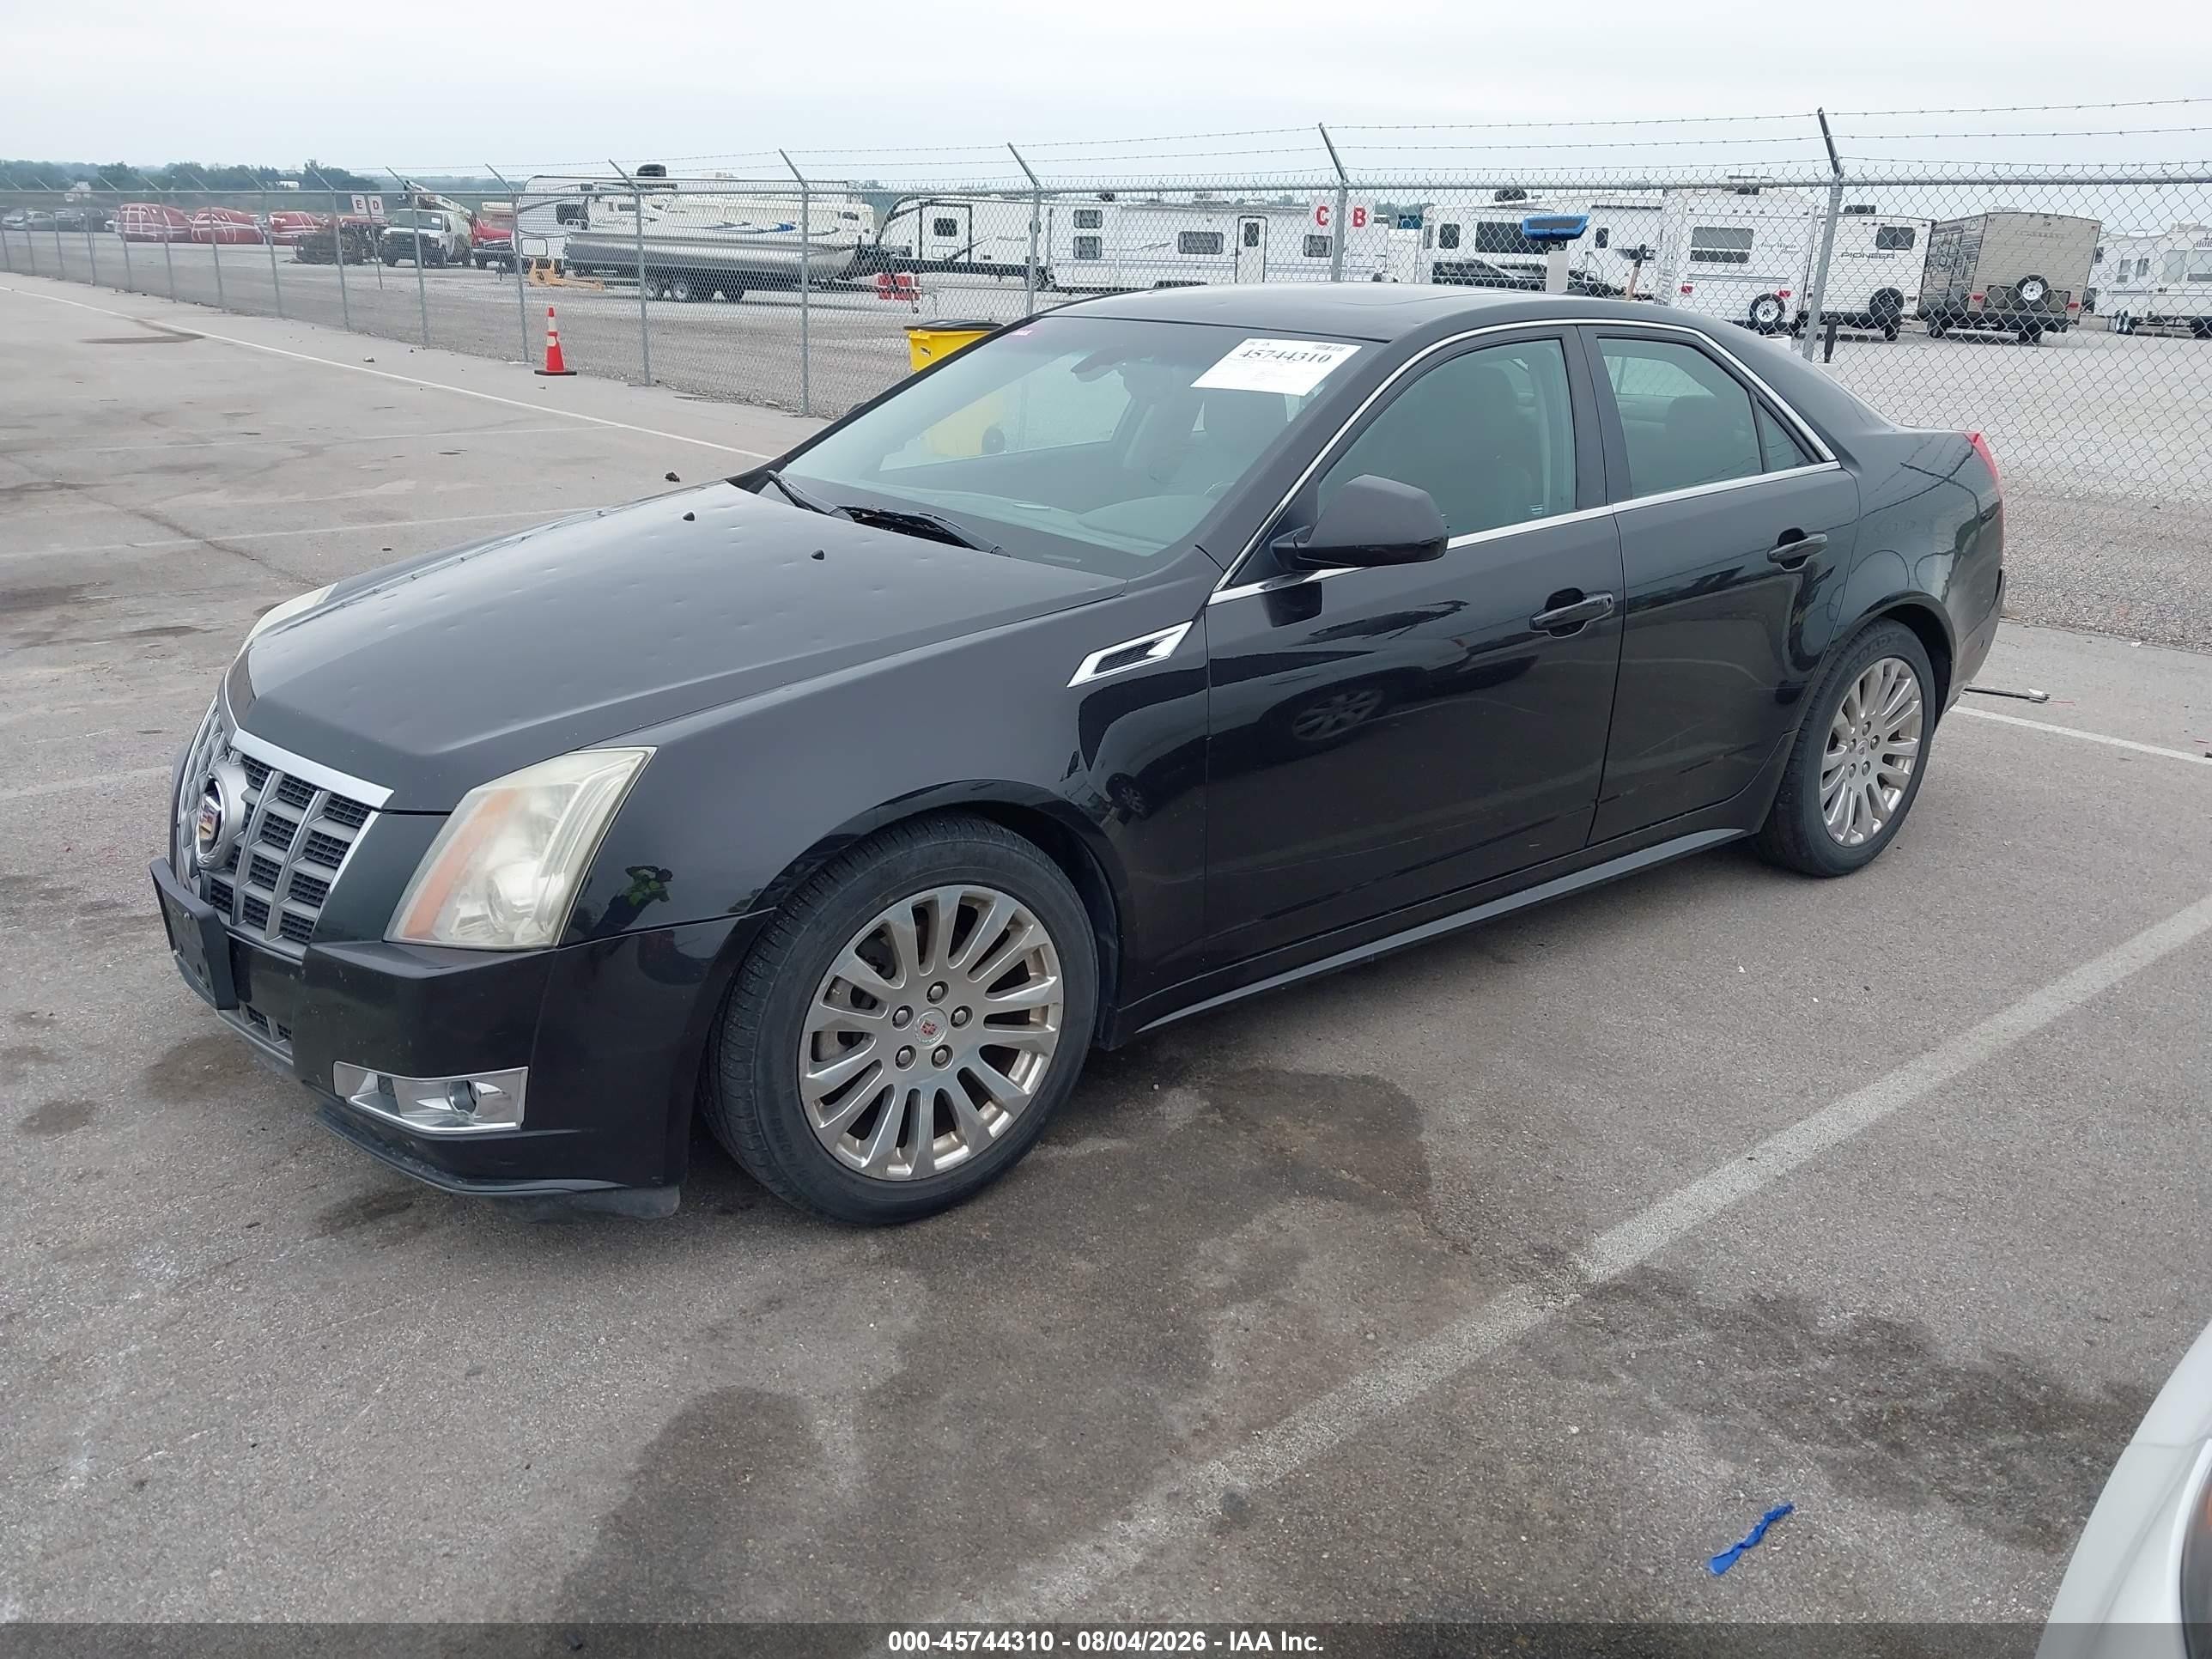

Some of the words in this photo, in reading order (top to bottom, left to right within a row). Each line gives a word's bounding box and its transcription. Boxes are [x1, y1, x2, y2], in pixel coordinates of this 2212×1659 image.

[356, 199, 363, 210] E
[373, 200, 380, 210] D
[1316, 206, 1329, 226] C
[1353, 207, 1366, 228] B
[1840, 252, 1896, 260] PIONEER
[1239, 349, 1332, 363] 45744310
